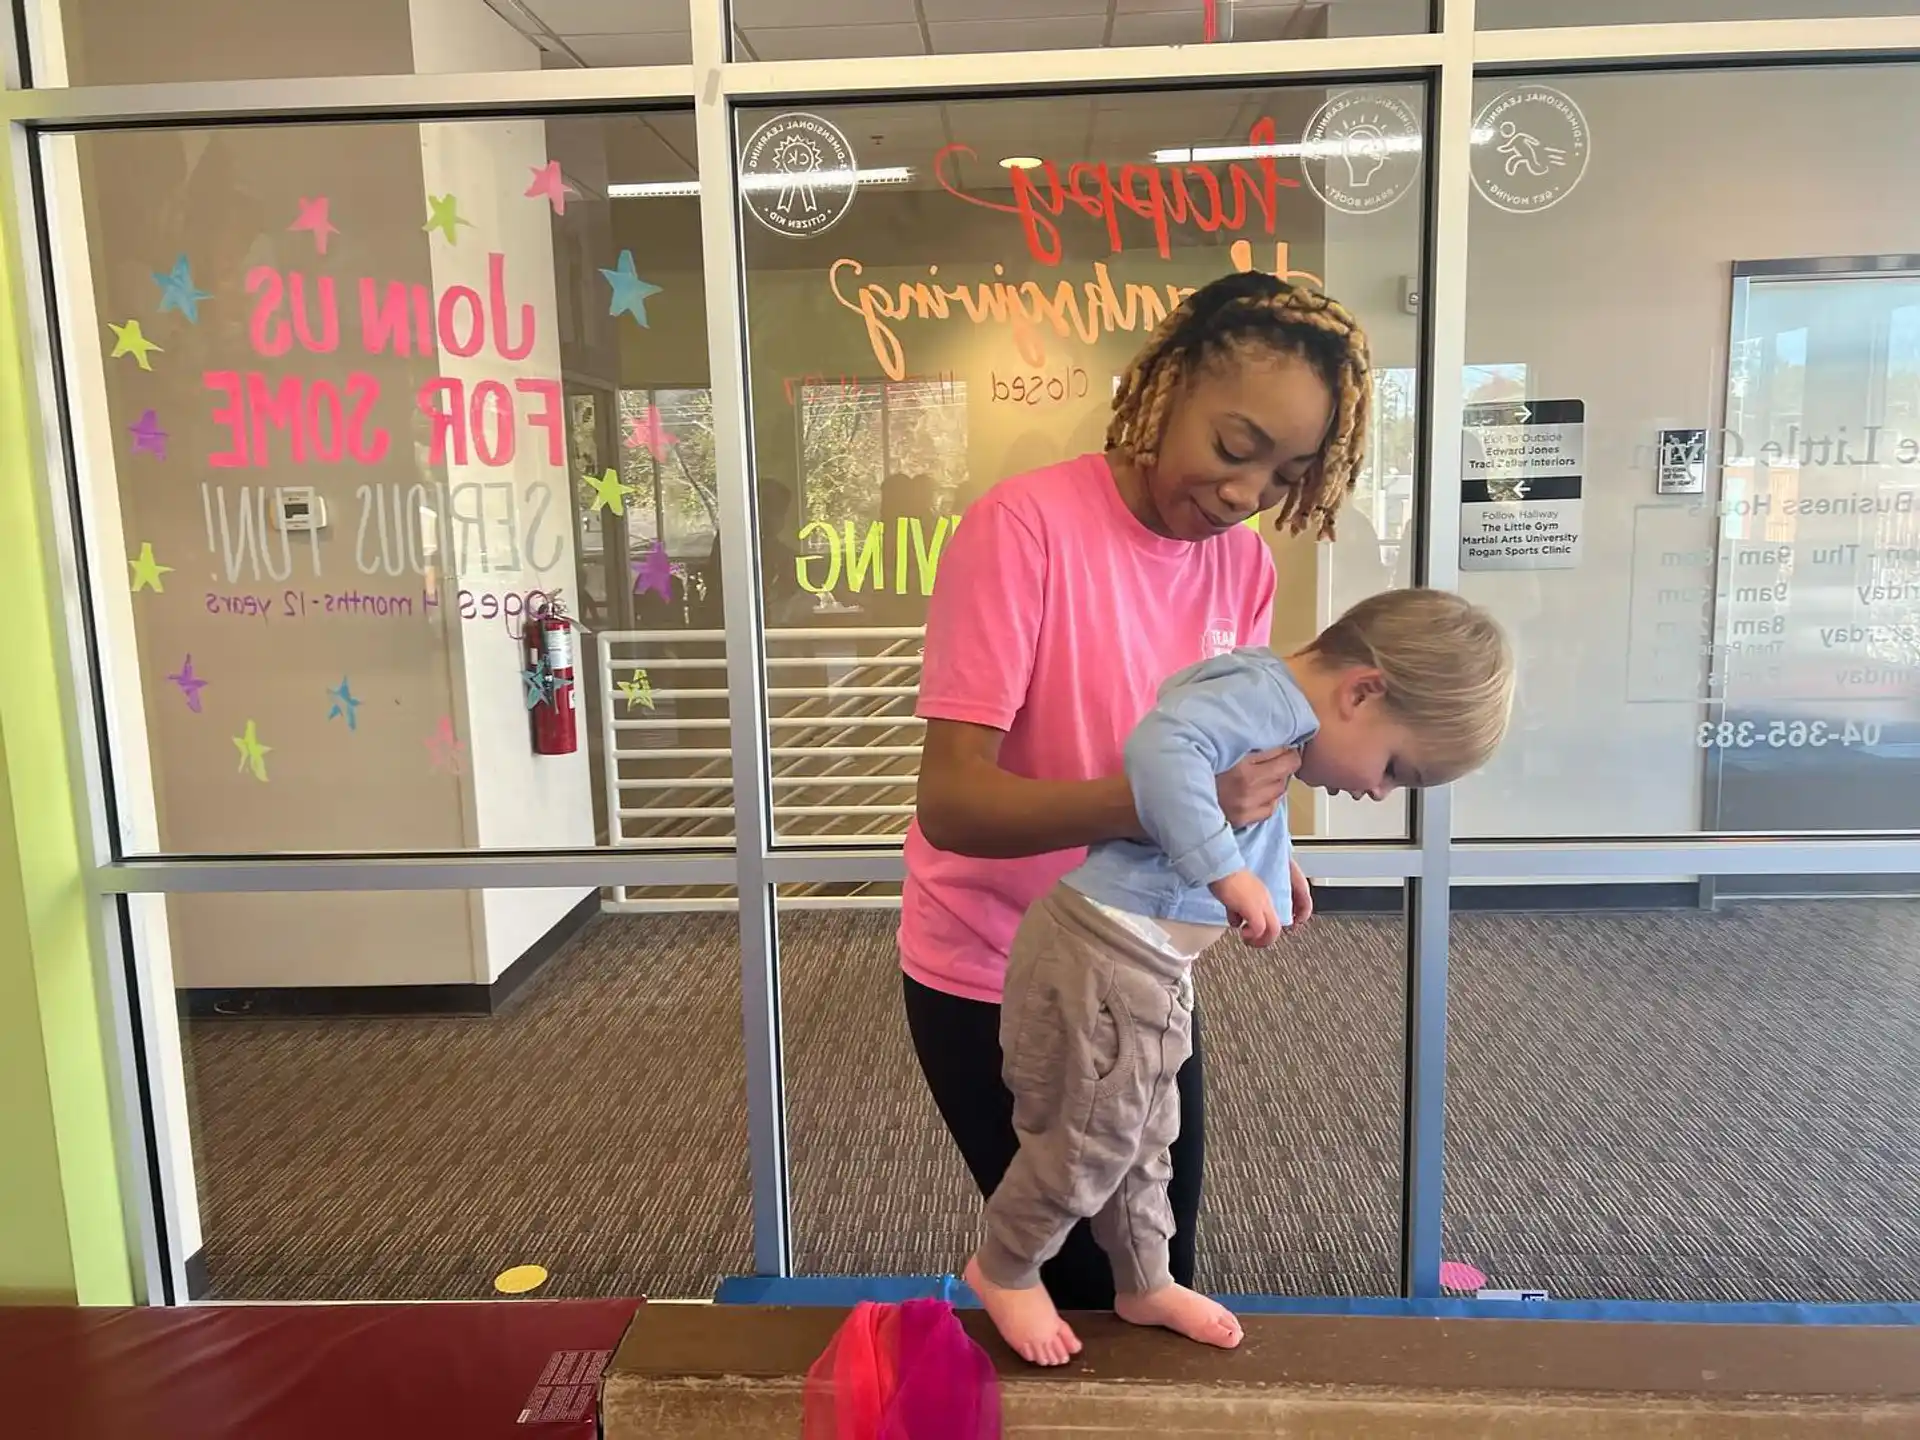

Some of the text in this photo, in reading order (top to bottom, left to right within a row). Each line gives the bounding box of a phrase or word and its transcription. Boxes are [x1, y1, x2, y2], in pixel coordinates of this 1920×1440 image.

[1486, 445, 1560, 456] Edward Jones
[1531, 456, 1576, 467] Interiors
[1482, 509, 1559, 520] Follow Hallway
[1482, 521, 1559, 532] The Little Gym
[1462, 533, 1579, 545] Martial Arts University
[1469, 544, 1572, 559] Rogan Sports Clinic
